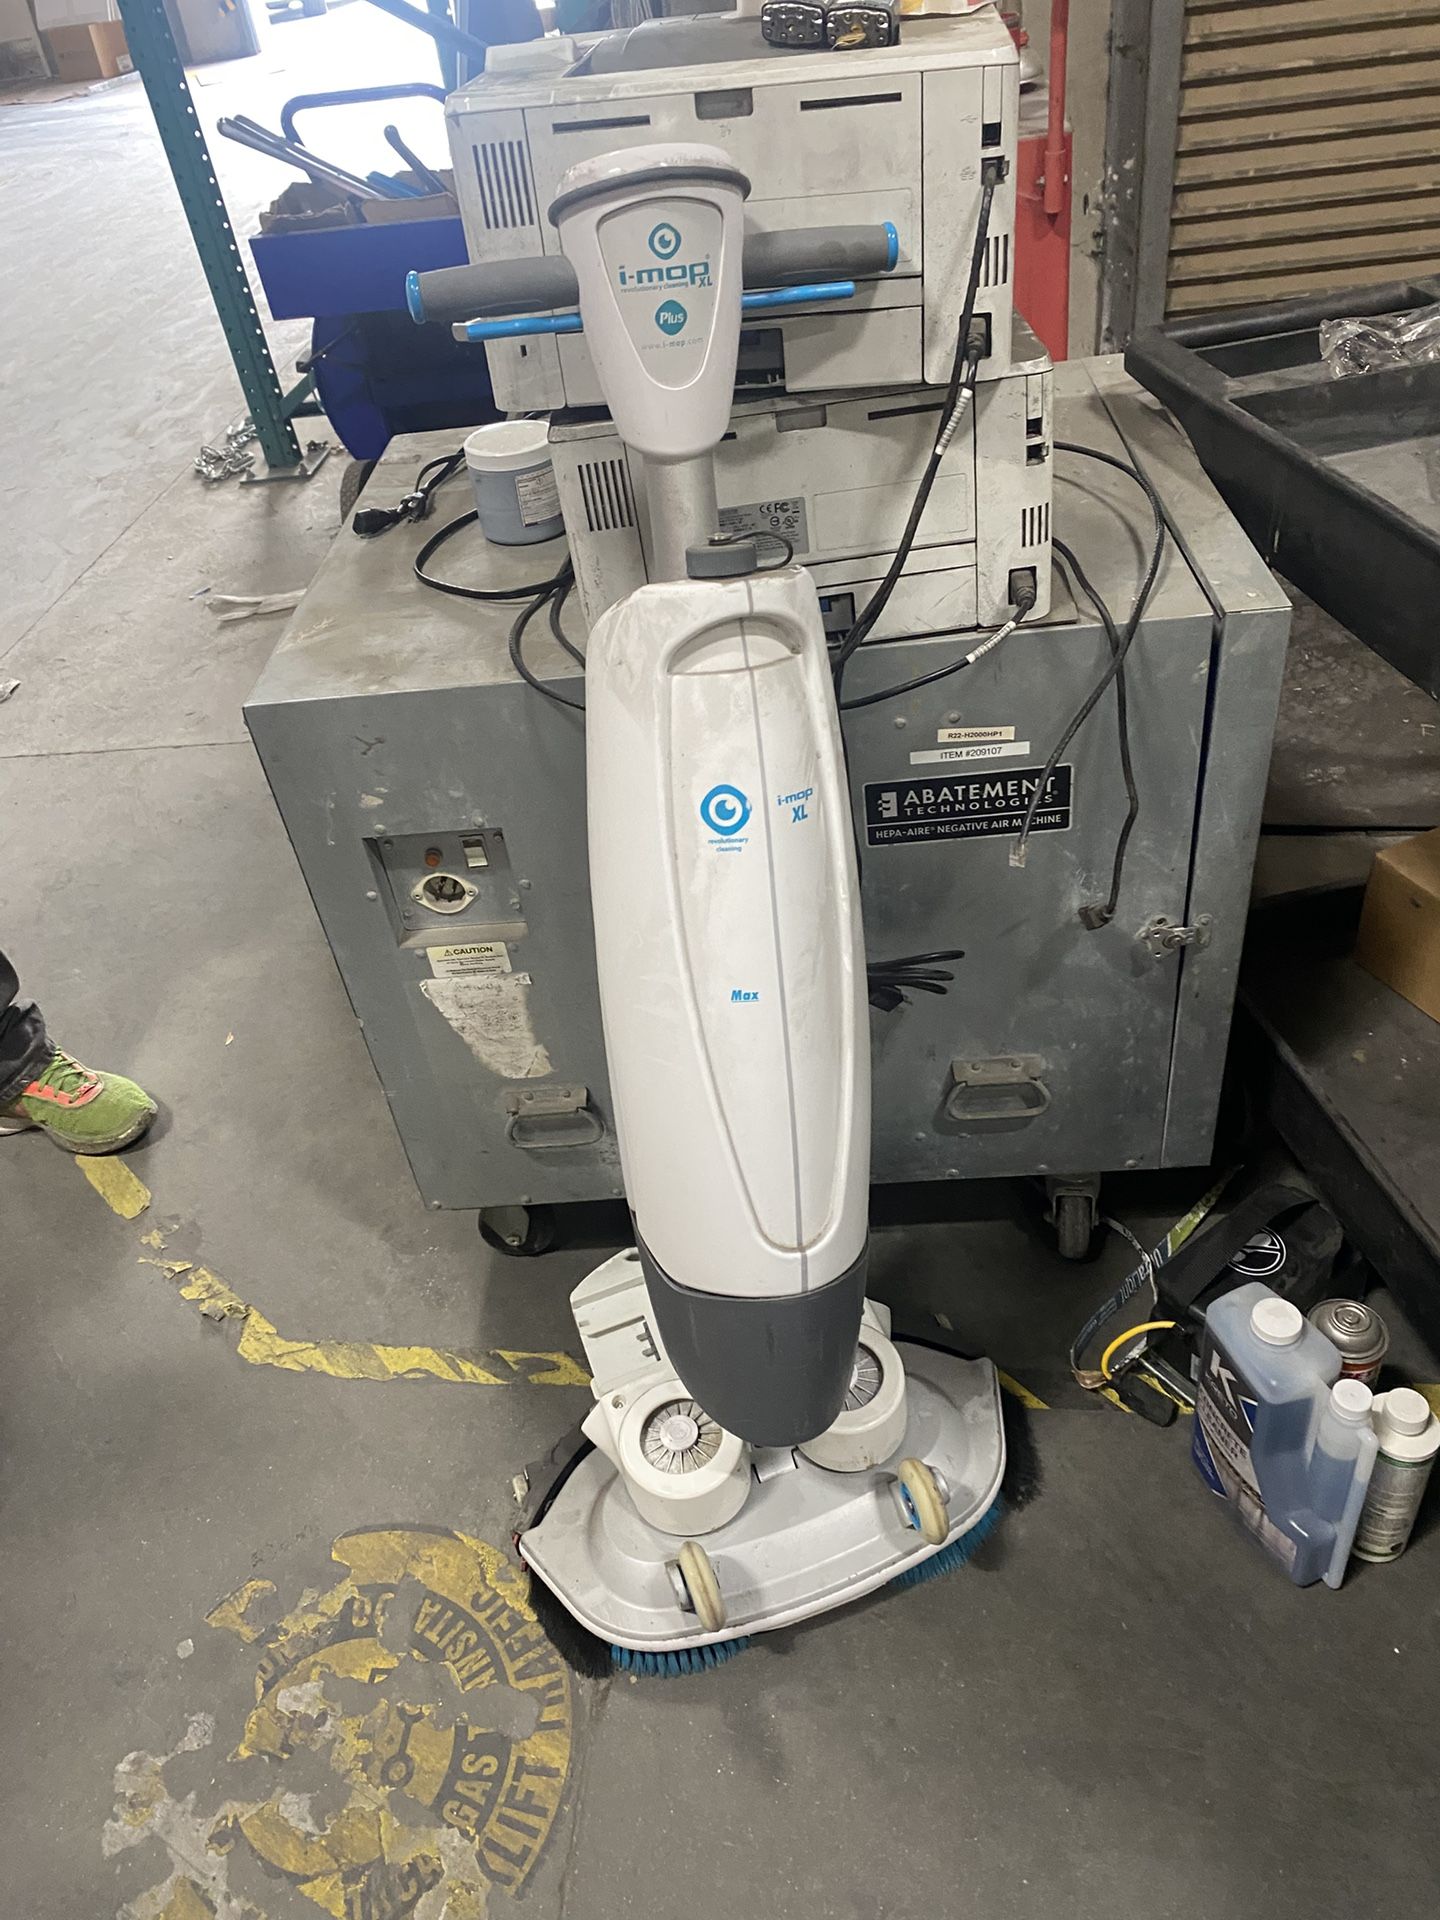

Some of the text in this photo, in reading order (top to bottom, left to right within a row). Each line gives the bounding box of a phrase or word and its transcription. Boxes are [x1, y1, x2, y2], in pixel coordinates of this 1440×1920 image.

[618, 261, 713, 288] i-mop XL
[659, 312, 685, 325] Plus
[941, 746, 1002, 760] ITEM #209107
[777, 787, 813, 806] i-mop
[903, 776, 1056, 806] ABATEMENT
[792, 804, 808, 823] XL
[904, 794, 1053, 816] TECHNOLOGIS
[937, 821, 989, 834] NEGATIVE
[991, 819, 1010, 829] AIR
[1012, 814, 1062, 827] MHINE
[453, 946, 493, 956] CAUTION
[731, 990, 759, 1002] Max
[1119, 1247, 1163, 1304] UraLight
